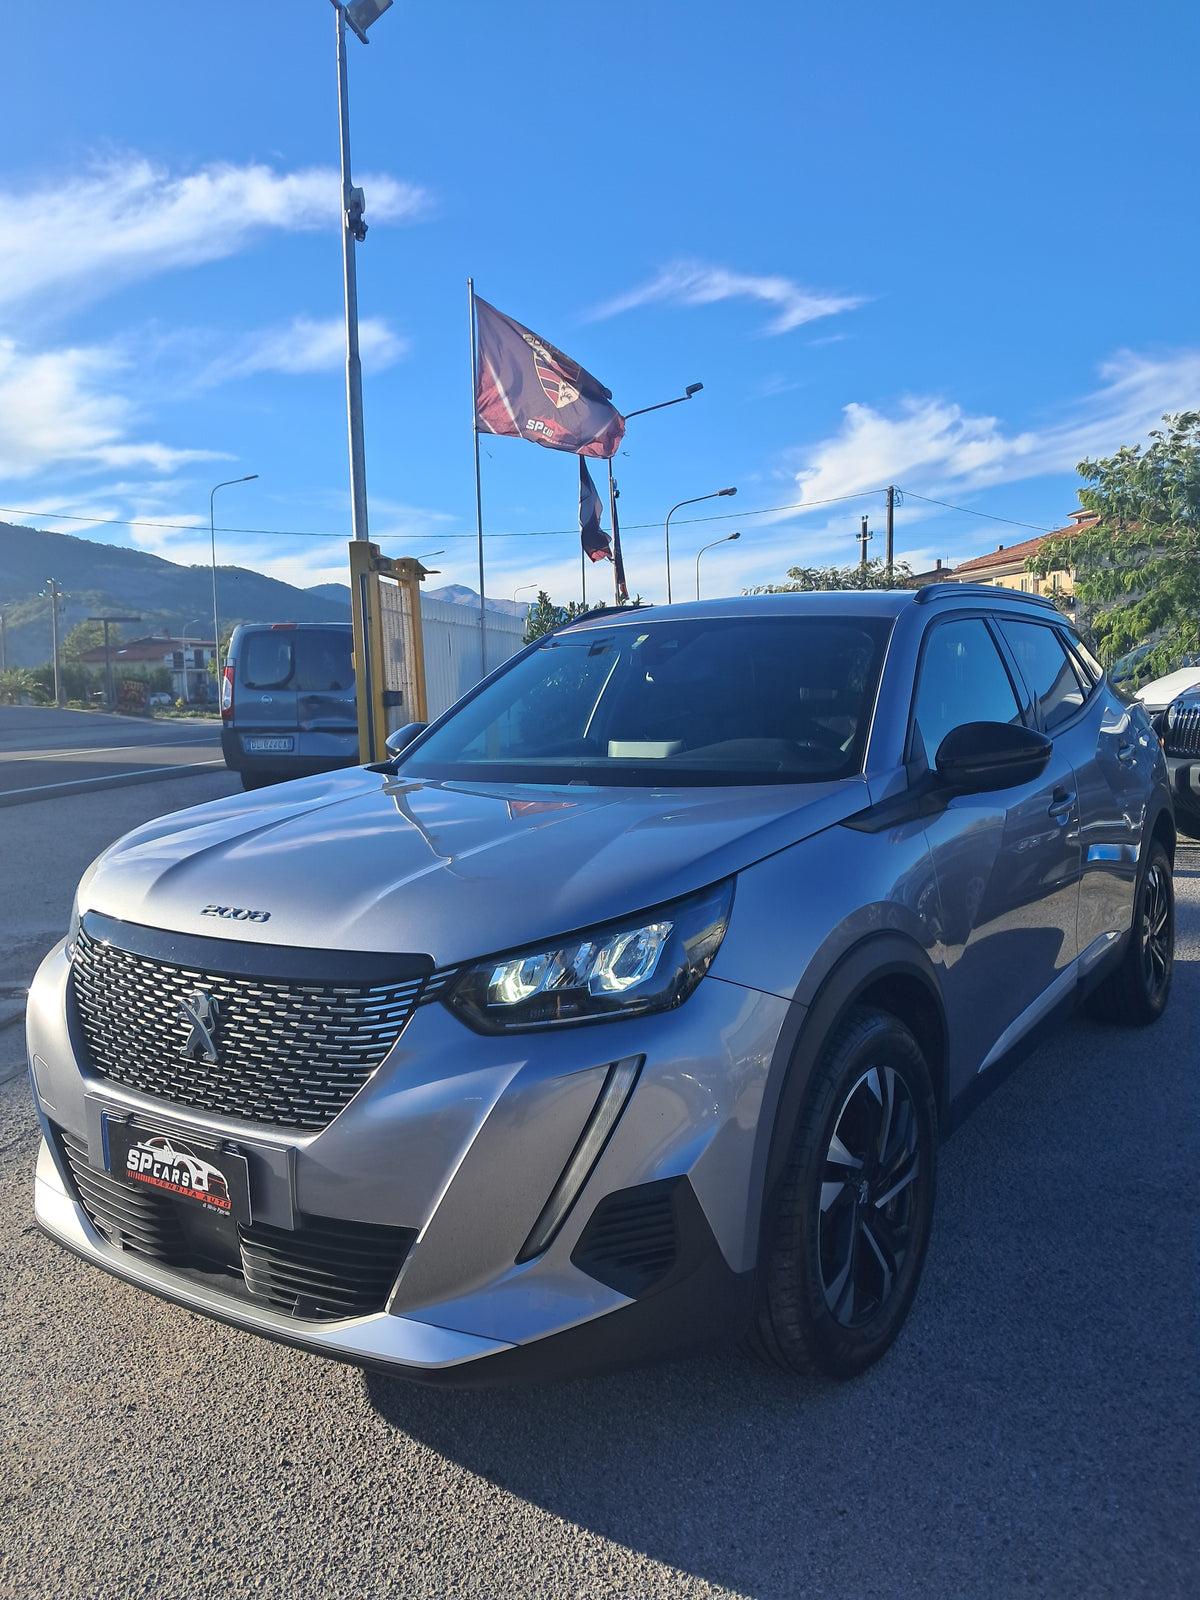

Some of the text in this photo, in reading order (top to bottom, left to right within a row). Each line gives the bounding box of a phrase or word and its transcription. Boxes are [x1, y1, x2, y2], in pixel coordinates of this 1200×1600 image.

[526, 419, 545, 431] SP
[200, 904, 272, 923] 2008
[126, 1149, 190, 1187] SP CARS
[155, 1179, 229, 1208] VENDITA AUTO
